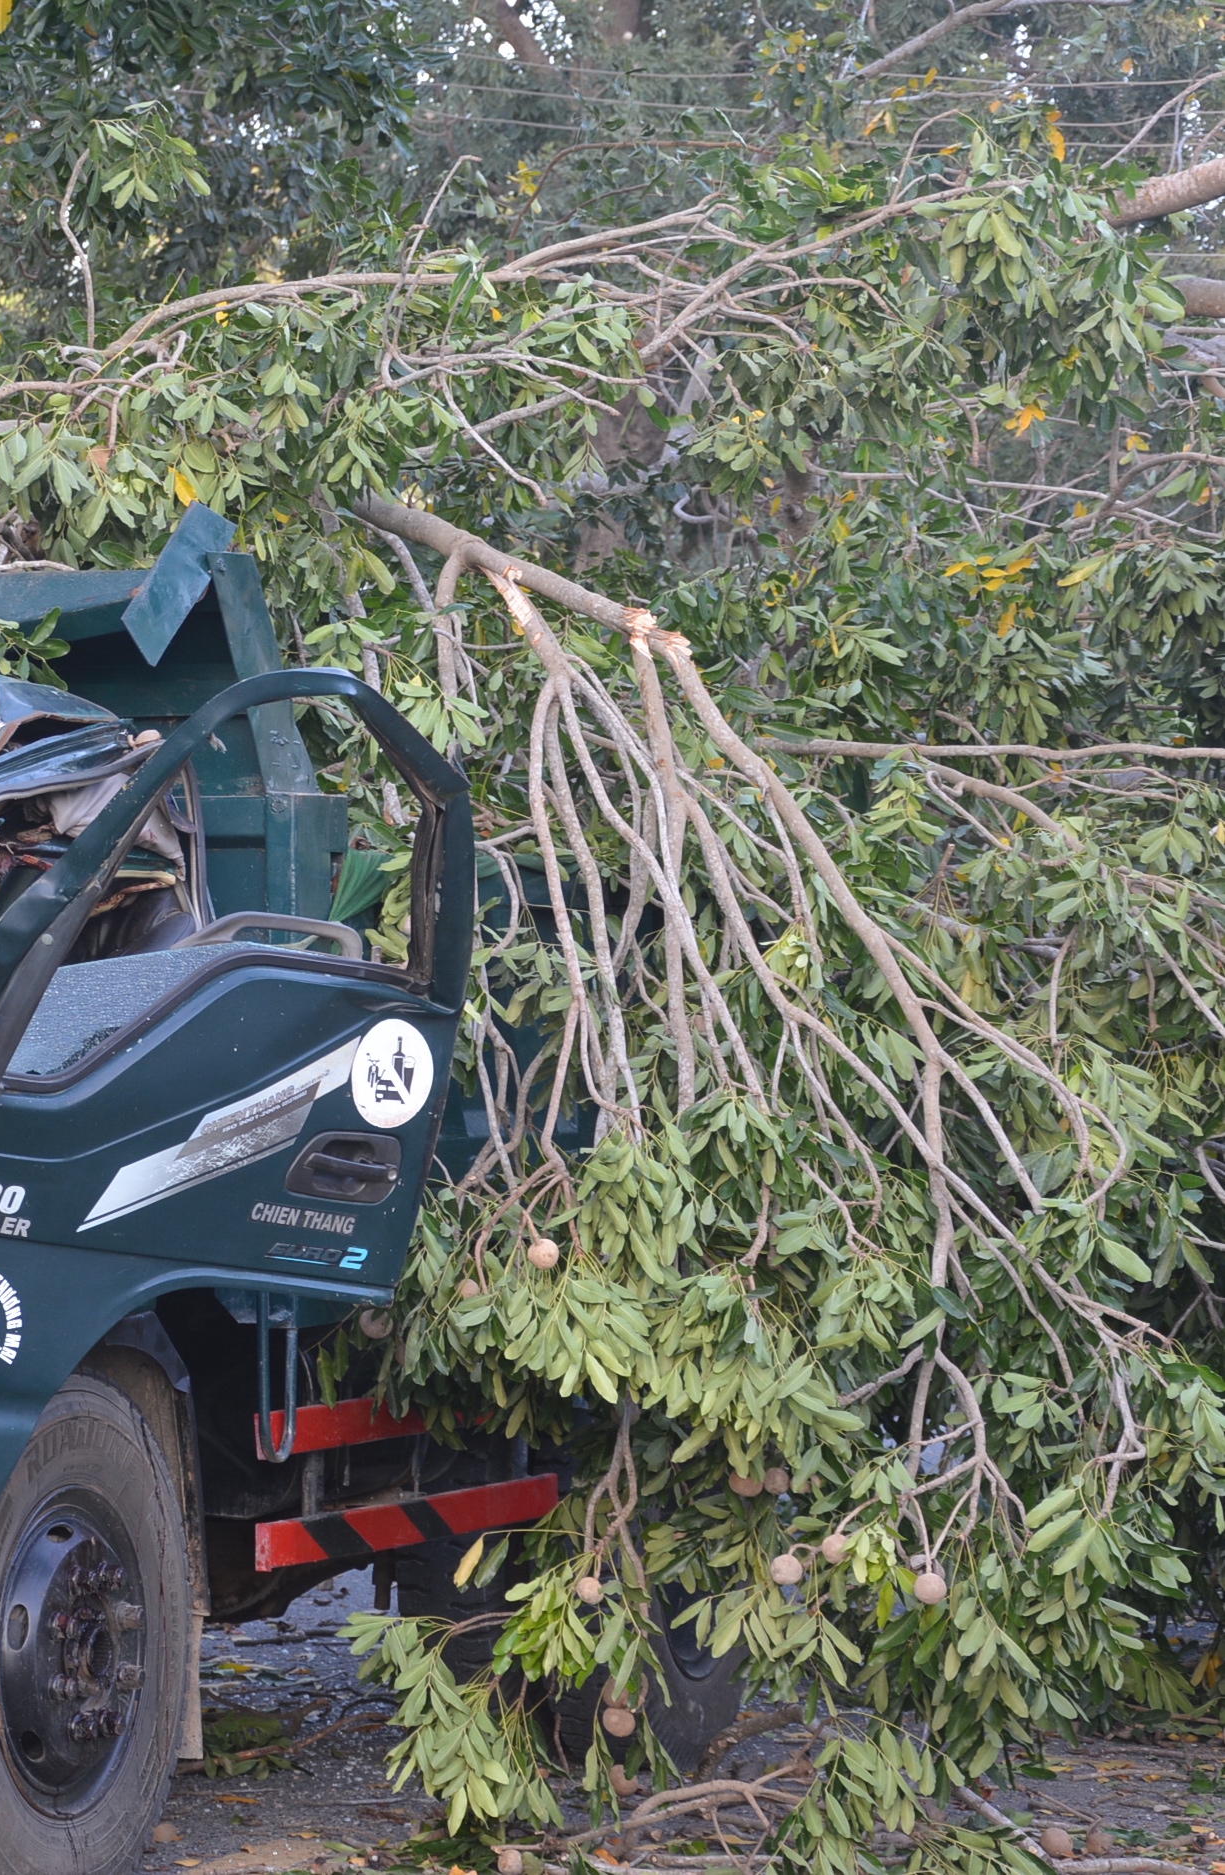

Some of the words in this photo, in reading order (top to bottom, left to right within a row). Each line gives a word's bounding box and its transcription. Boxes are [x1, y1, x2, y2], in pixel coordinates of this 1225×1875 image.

[222, 1123, 238, 1133] ISO
[251, 1202, 301, 1227] CHIEN
[303, 1210, 356, 1235] THANG
